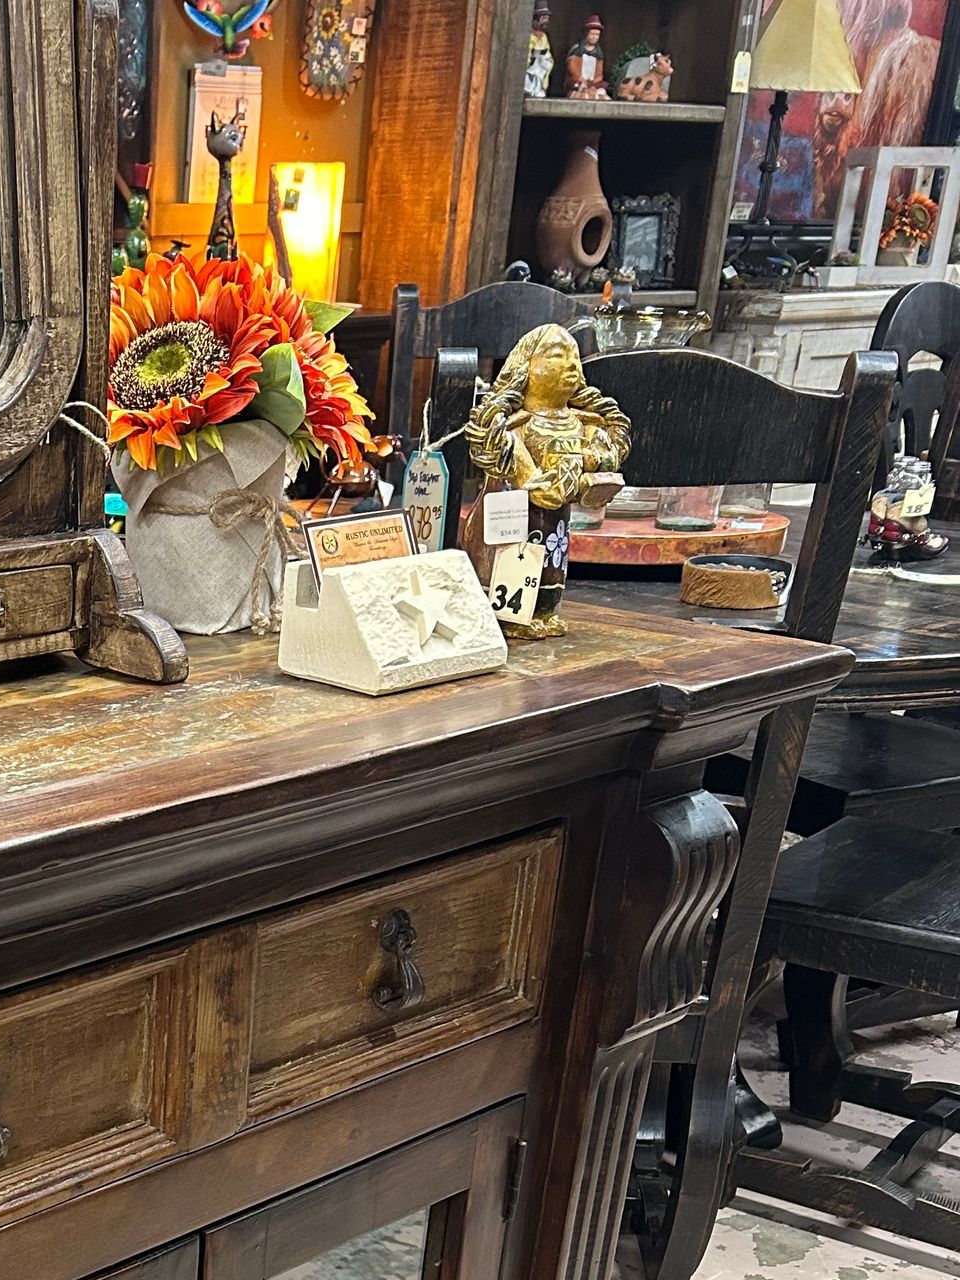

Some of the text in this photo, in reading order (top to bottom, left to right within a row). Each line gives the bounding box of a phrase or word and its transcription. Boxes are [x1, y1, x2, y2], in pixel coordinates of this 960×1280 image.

[906, 504, 924, 514] 18
[345, 530, 369, 541] RUSTIC
[369, 525, 403, 537] UNLIMITED
[524, 576, 538, 588] 95
[491, 584, 524, 615] 34
